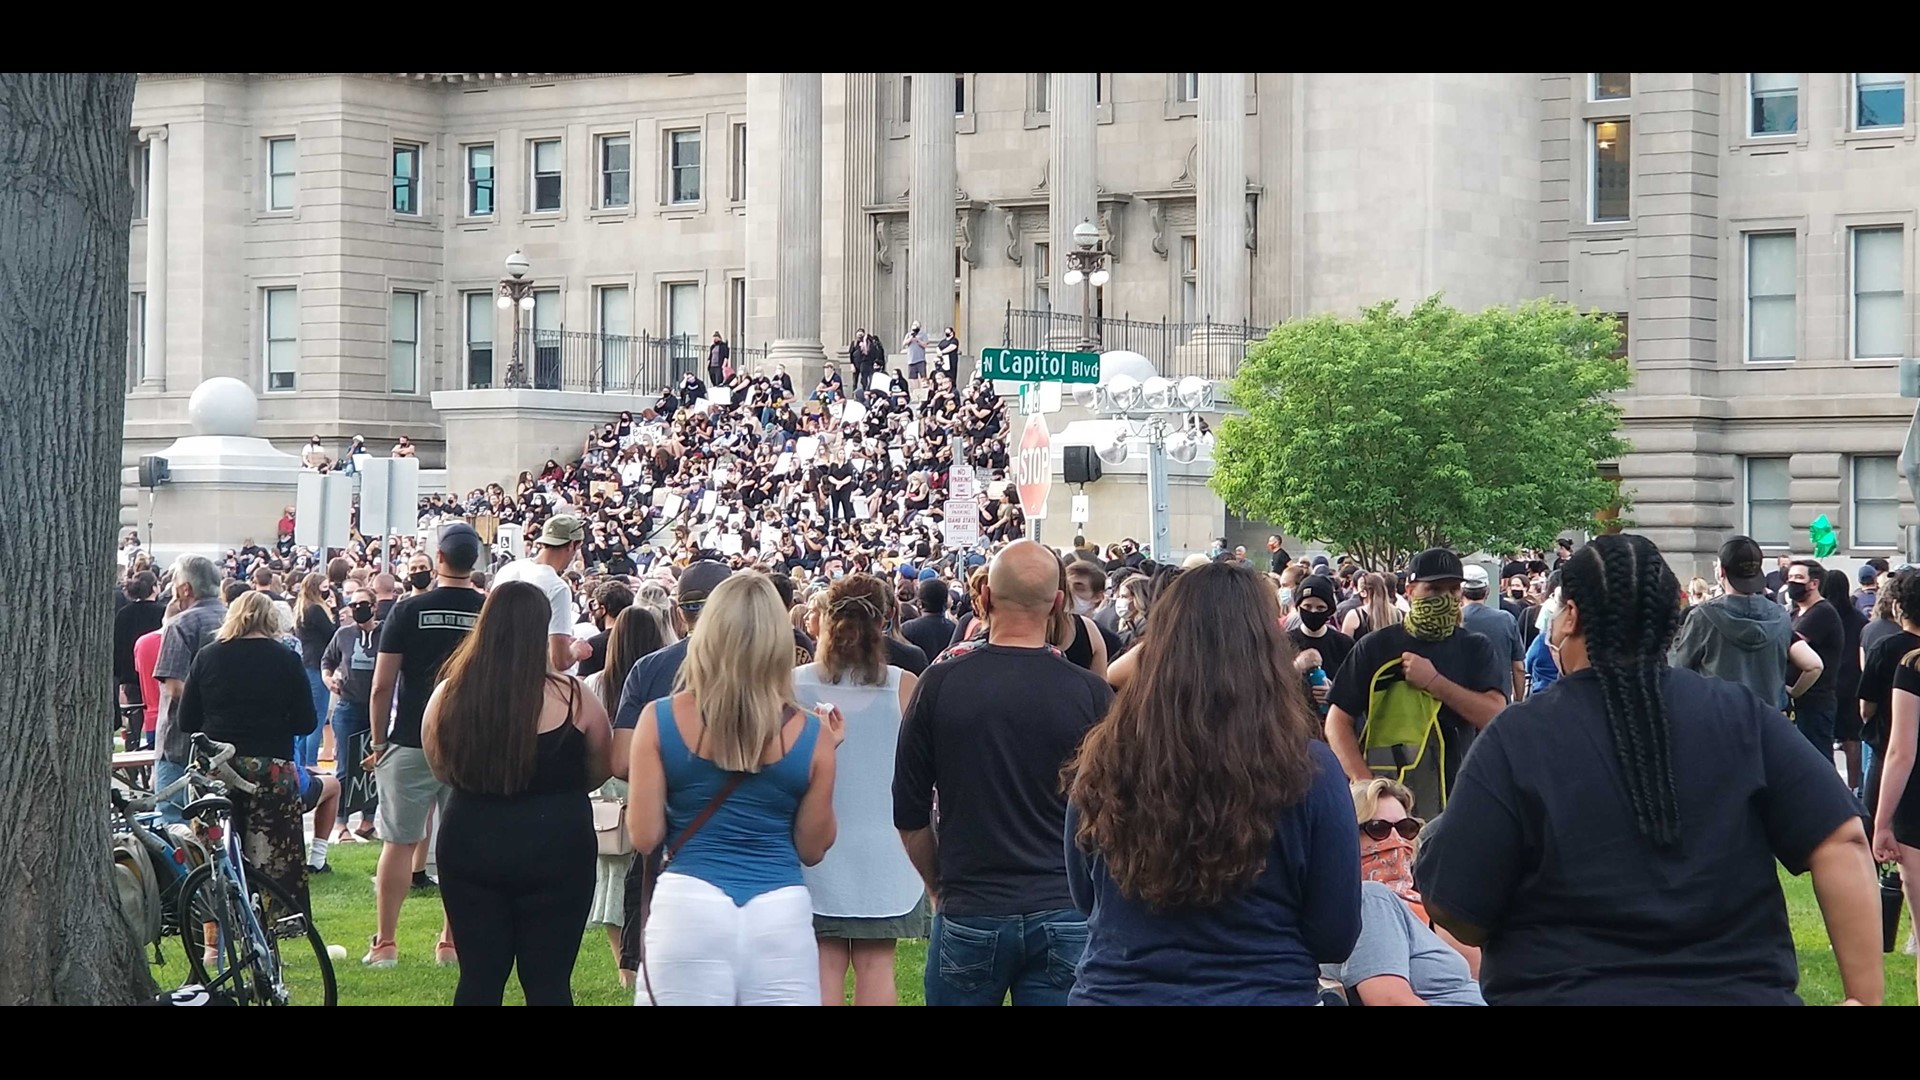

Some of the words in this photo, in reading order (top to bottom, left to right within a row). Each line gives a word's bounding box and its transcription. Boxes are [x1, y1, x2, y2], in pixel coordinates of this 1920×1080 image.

[984, 356, 993, 373] N
[999, 350, 1066, 380] Capitol
[1071, 360, 1098, 378] Blvd
[957, 468, 966, 476] NO
[1020, 446, 1049, 486] STOP
